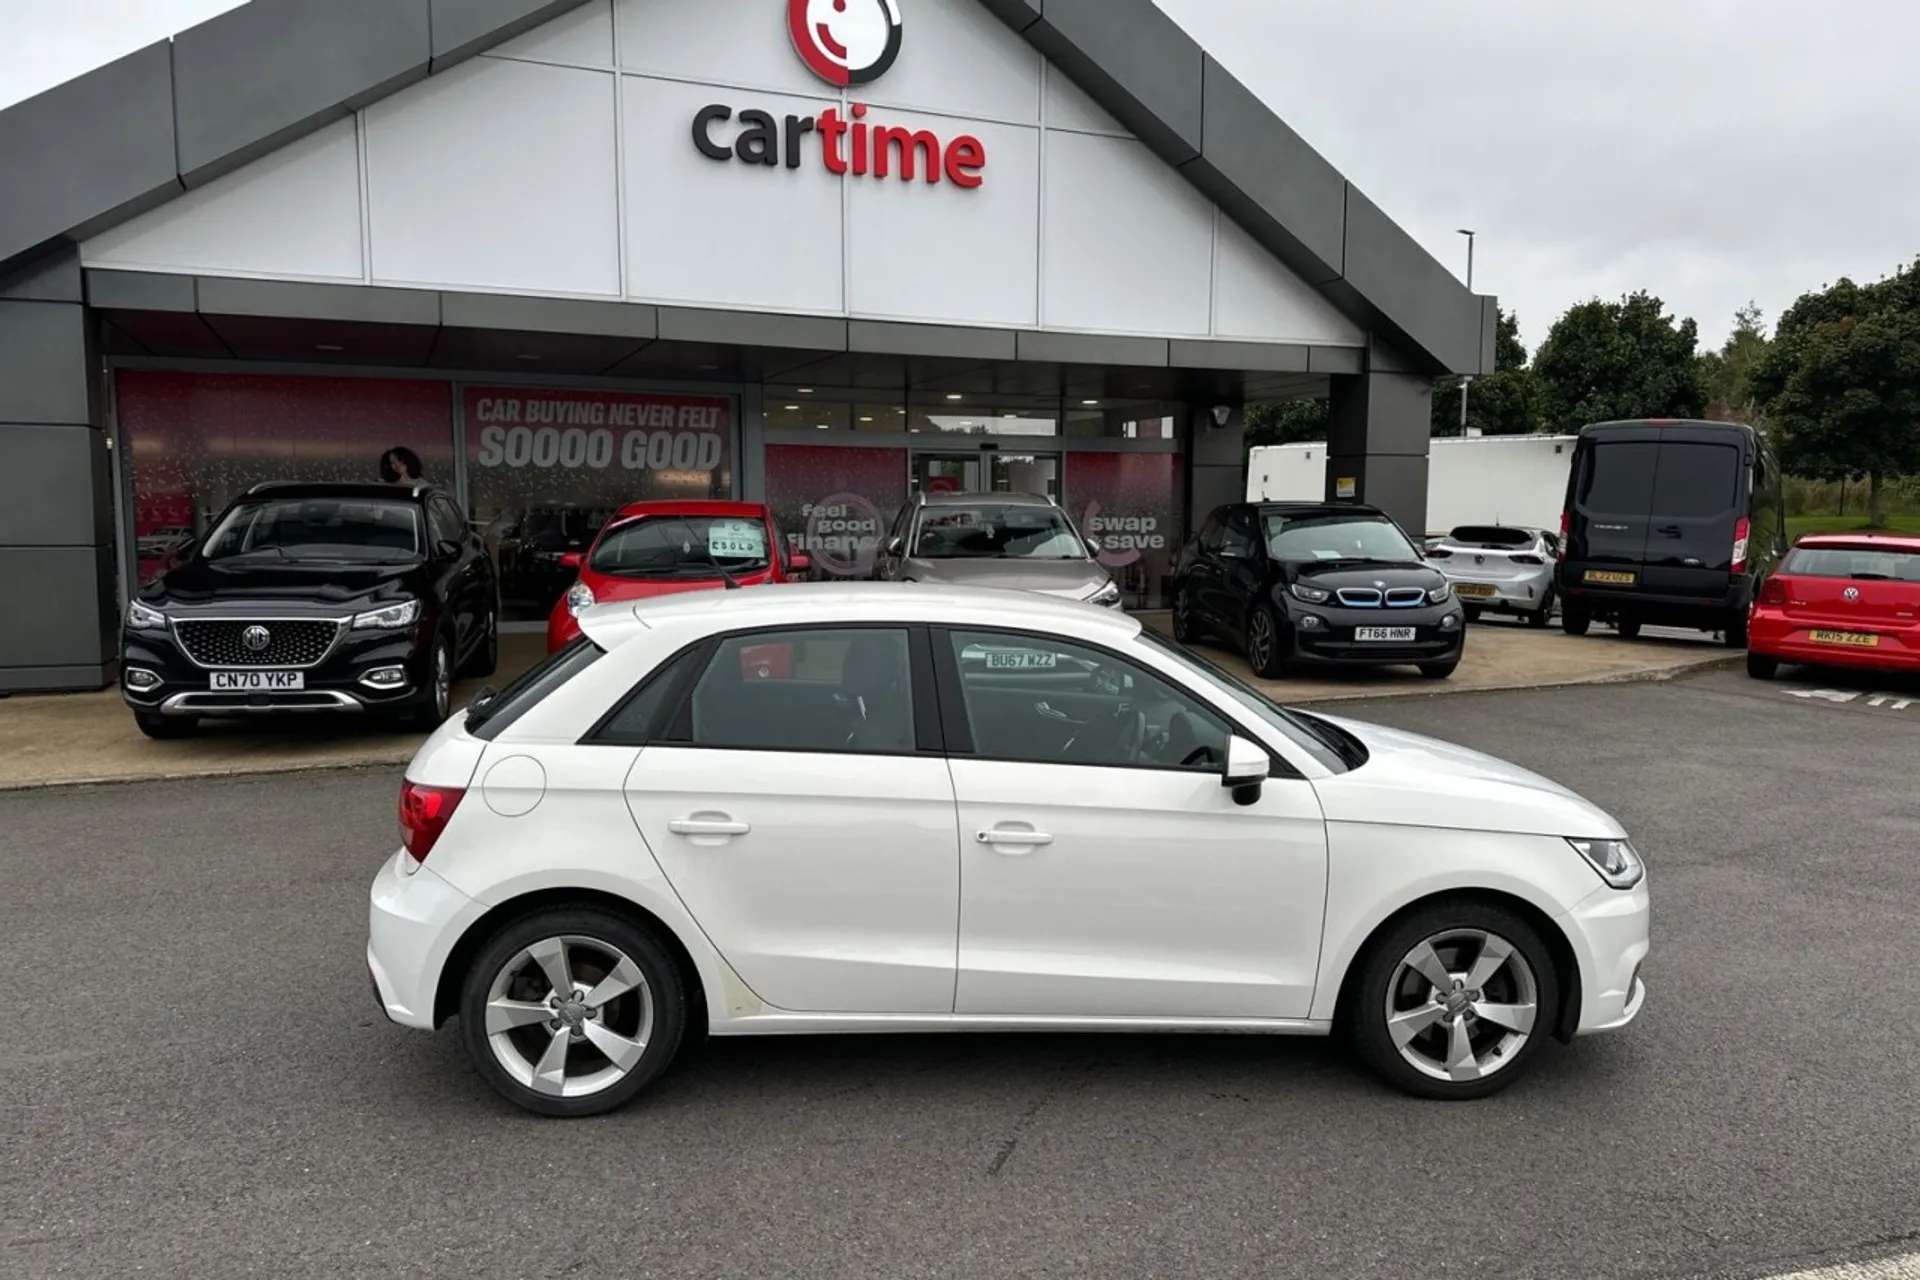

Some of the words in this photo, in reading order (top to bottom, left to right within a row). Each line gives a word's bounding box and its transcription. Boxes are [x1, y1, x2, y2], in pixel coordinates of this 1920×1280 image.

[692, 103, 985, 188] cartime
[477, 399, 520, 422] CAR
[525, 400, 604, 425] BUYING
[608, 403, 674, 427] NEVER
[678, 406, 720, 429] FELT
[478, 426, 613, 469] SOOOO
[621, 430, 722, 470] GOOD
[802, 504, 847, 517] feel
[818, 519, 876, 533] good
[1089, 516, 1156, 533] swap
[1104, 534, 1164, 549] save
[1360, 629, 1387, 638] FT66
[1390, 629, 1411, 638] HNR
[992, 653, 1023, 666] BU67
[216, 673, 260, 687] CN70
[265, 673, 297, 687] YKP
